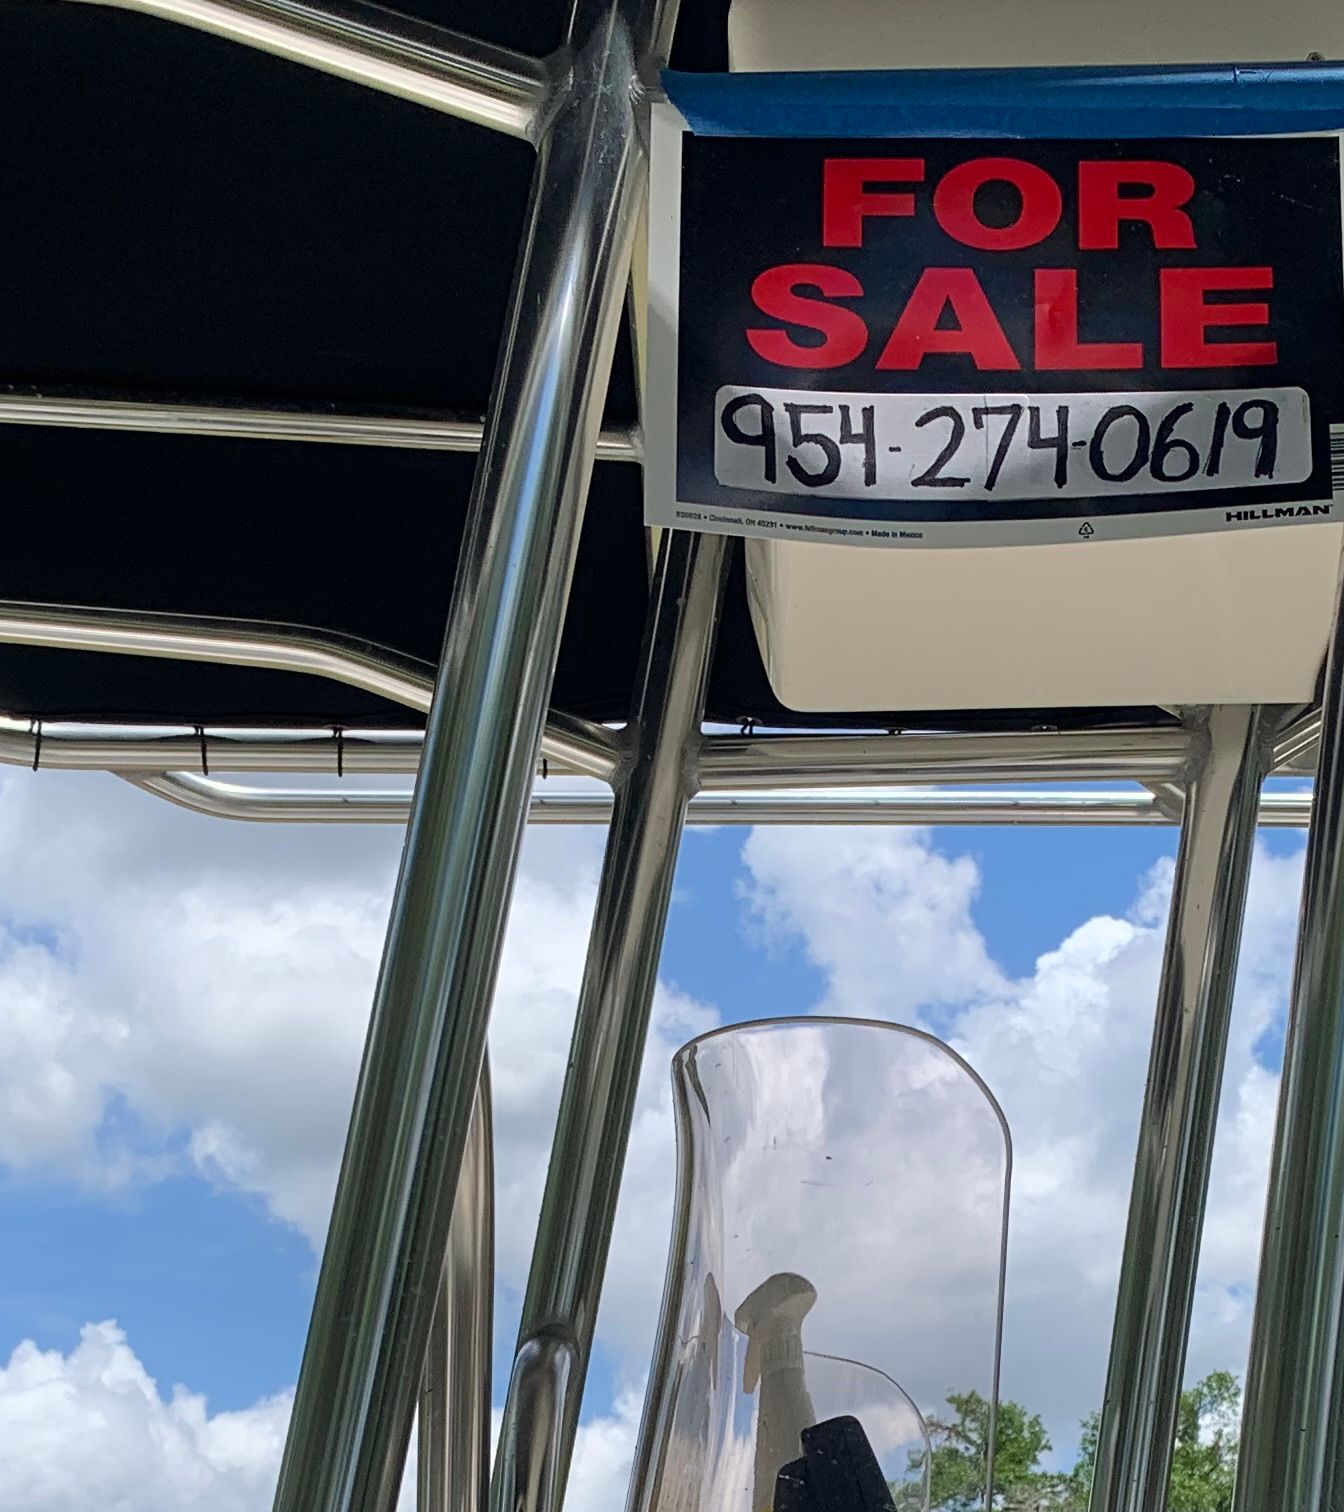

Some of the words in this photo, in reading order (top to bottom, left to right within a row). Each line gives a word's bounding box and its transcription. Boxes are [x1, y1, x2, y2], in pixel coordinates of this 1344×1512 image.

[821, 157, 1198, 252] FOR
[745, 263, 1279, 373] SALE
[720, 392, 1281, 492] 954-274-0619
[871, 529, 890, 538] Made
[1225, 505, 1331, 522] HILLMAN
